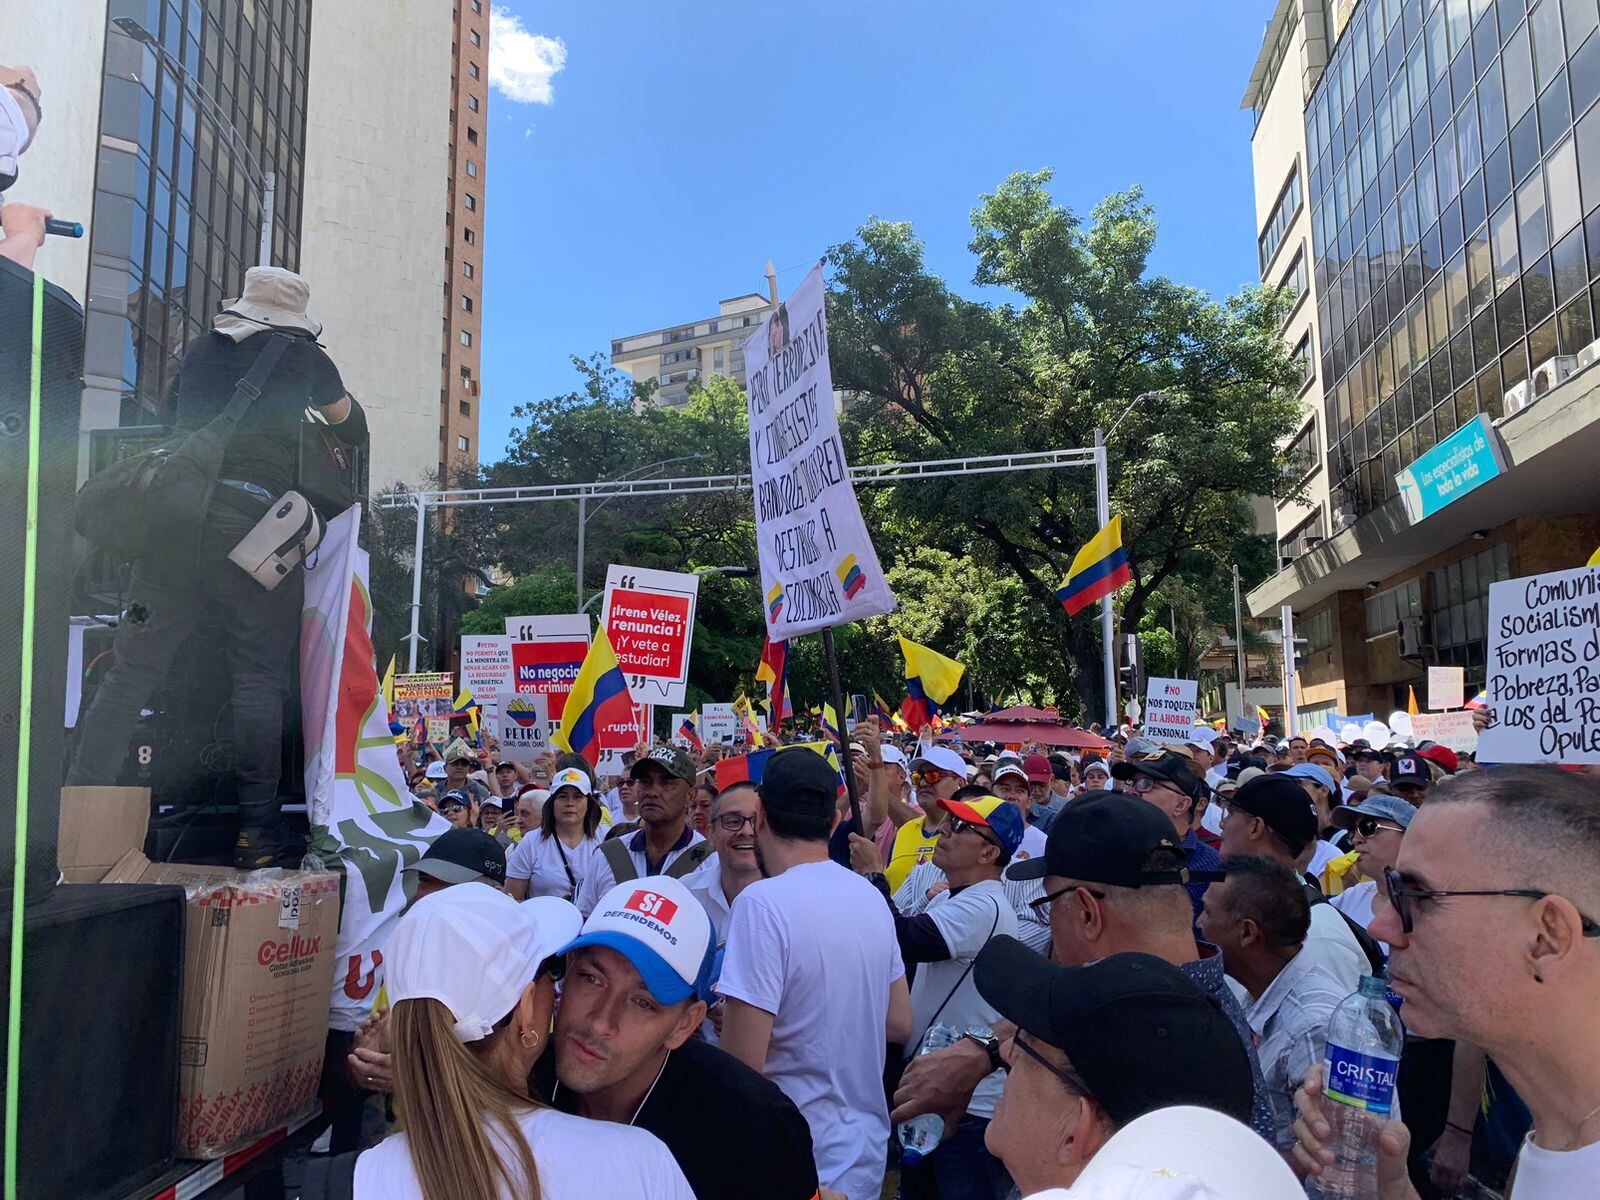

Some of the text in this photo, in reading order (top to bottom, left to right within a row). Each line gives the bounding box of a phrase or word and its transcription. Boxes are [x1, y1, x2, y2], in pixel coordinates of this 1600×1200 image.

[1473, 431, 1486, 452] de
[820, 507, 837, 553] A
[785, 570, 842, 624] COLOMBIA
[612, 604, 648, 618] ¡Irene
[616, 634, 670, 653] ¡Y vete a
[615, 652, 671, 668] estudiar!
[1494, 638, 1578, 669] Formas
[519, 665, 536, 680] No
[398, 688, 450, 697] WARNING
[518, 683, 537, 693] con
[1164, 684, 1181, 696] #NO
[1490, 673, 1574, 702] Pobreza,
[1147, 698, 1196, 712] NOS TOQUEN
[1540, 696, 1573, 725] del
[1149, 712, 1192, 726] EL AHORRO
[505, 727, 542, 741] PETRO
[1147, 726, 1190, 740] PENSIONAL
[602, 910, 679, 946] DEFENDEMOS
[257, 935, 321, 966] Cellux
[1336, 1060, 1395, 1087] CRISTAL
